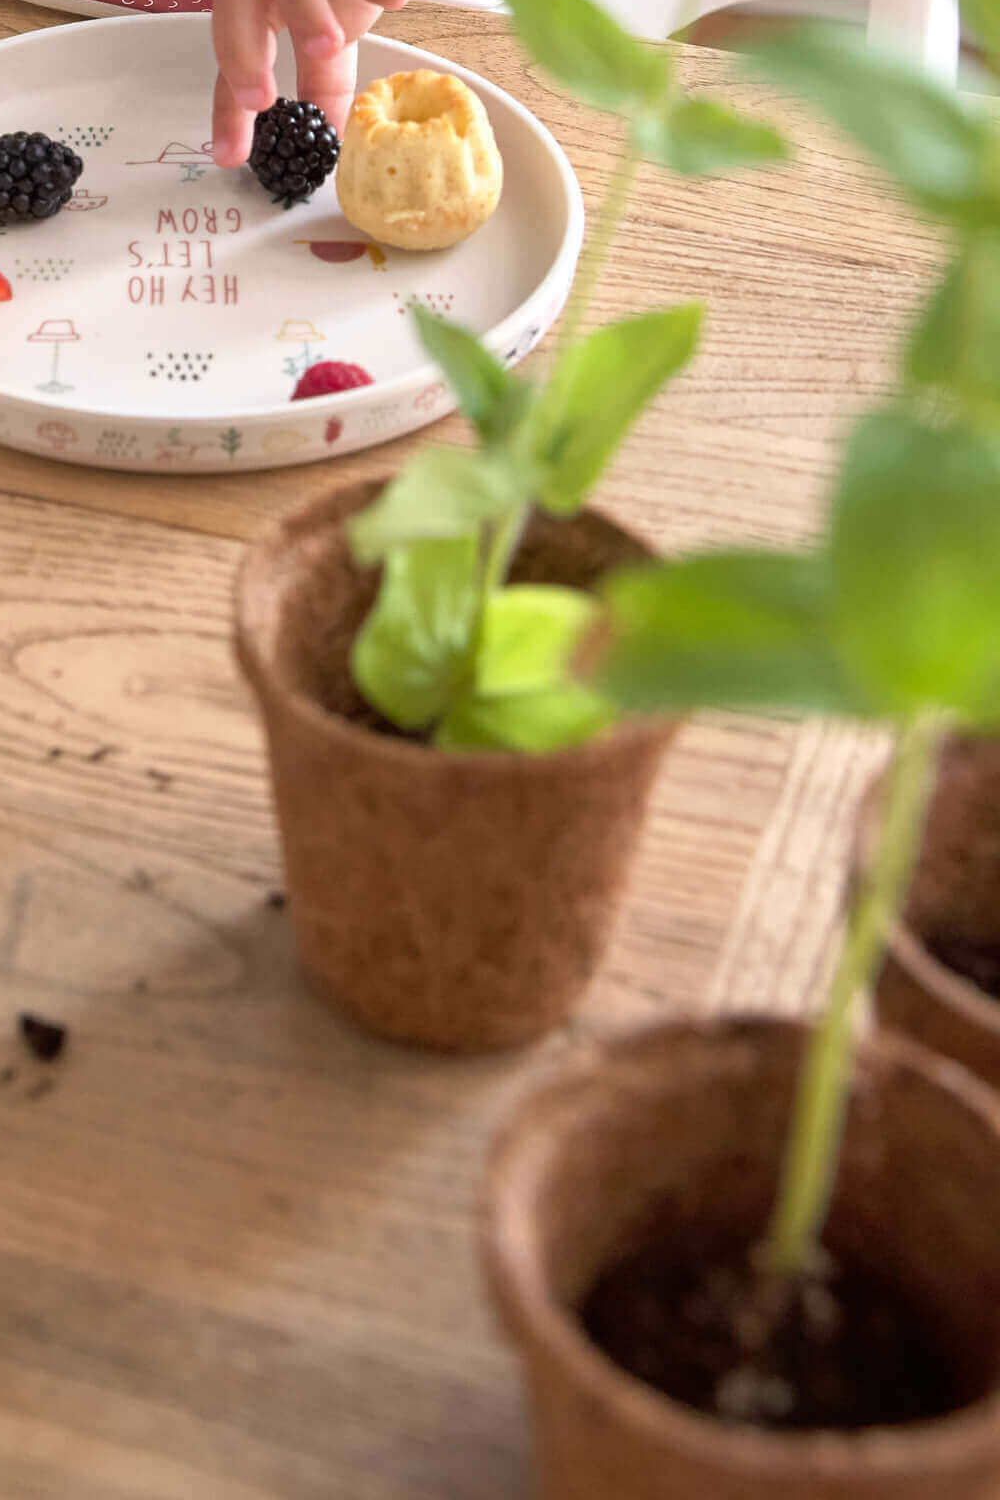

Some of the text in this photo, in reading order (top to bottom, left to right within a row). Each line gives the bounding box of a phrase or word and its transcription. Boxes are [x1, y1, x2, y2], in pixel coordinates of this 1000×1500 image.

[156, 206, 241, 234] GROW
[127, 239, 212, 269] LET'S
[127, 274, 239, 305] HEY HO
